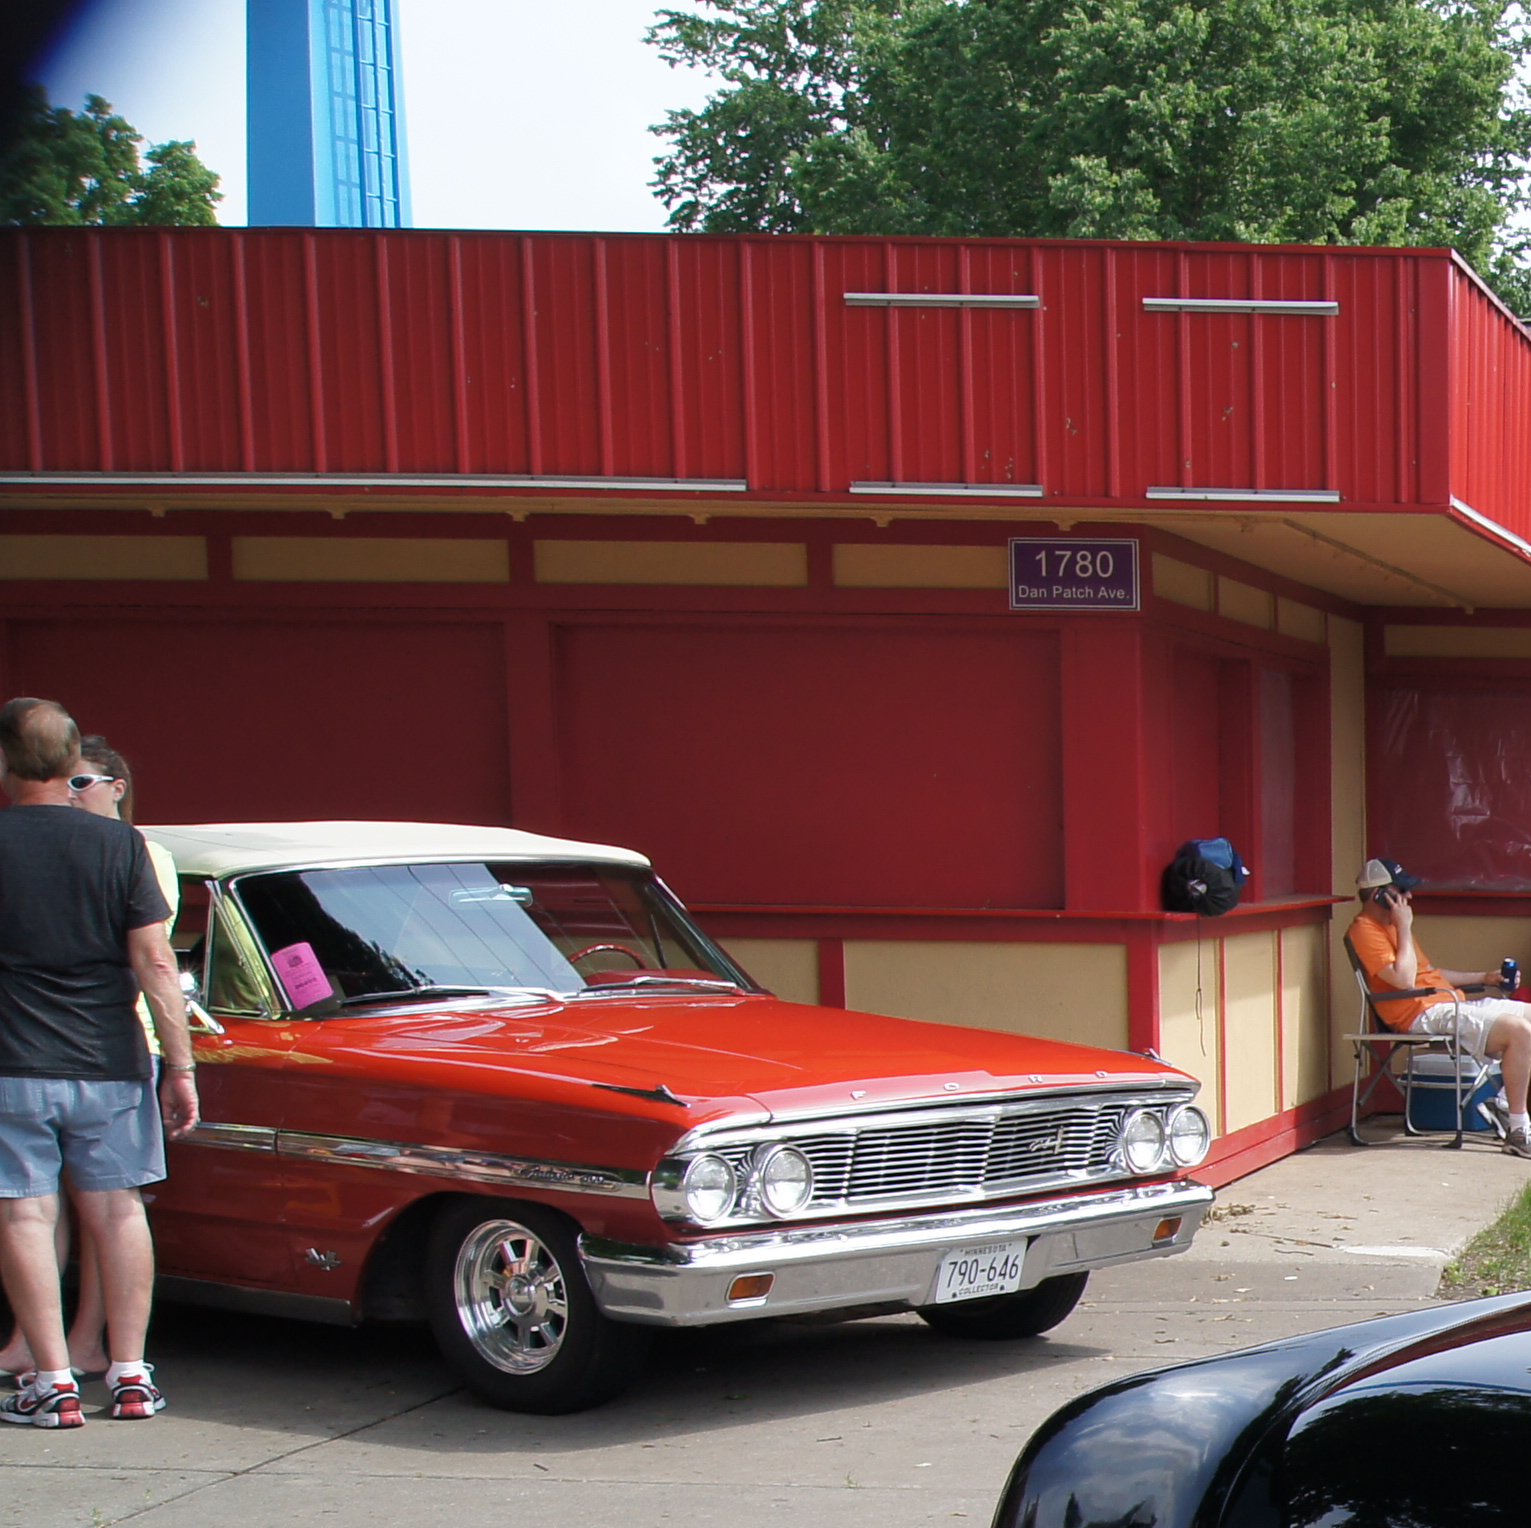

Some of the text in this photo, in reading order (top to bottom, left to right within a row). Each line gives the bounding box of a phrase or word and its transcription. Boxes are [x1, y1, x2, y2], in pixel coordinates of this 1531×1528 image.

[1035, 550, 1114, 578] 1780
[1018, 585, 1130, 599] Dan Patch Ave.
[946, 1254, 1019, 1288] 790-646
[958, 1282, 999, 1296] COLLECTOR
